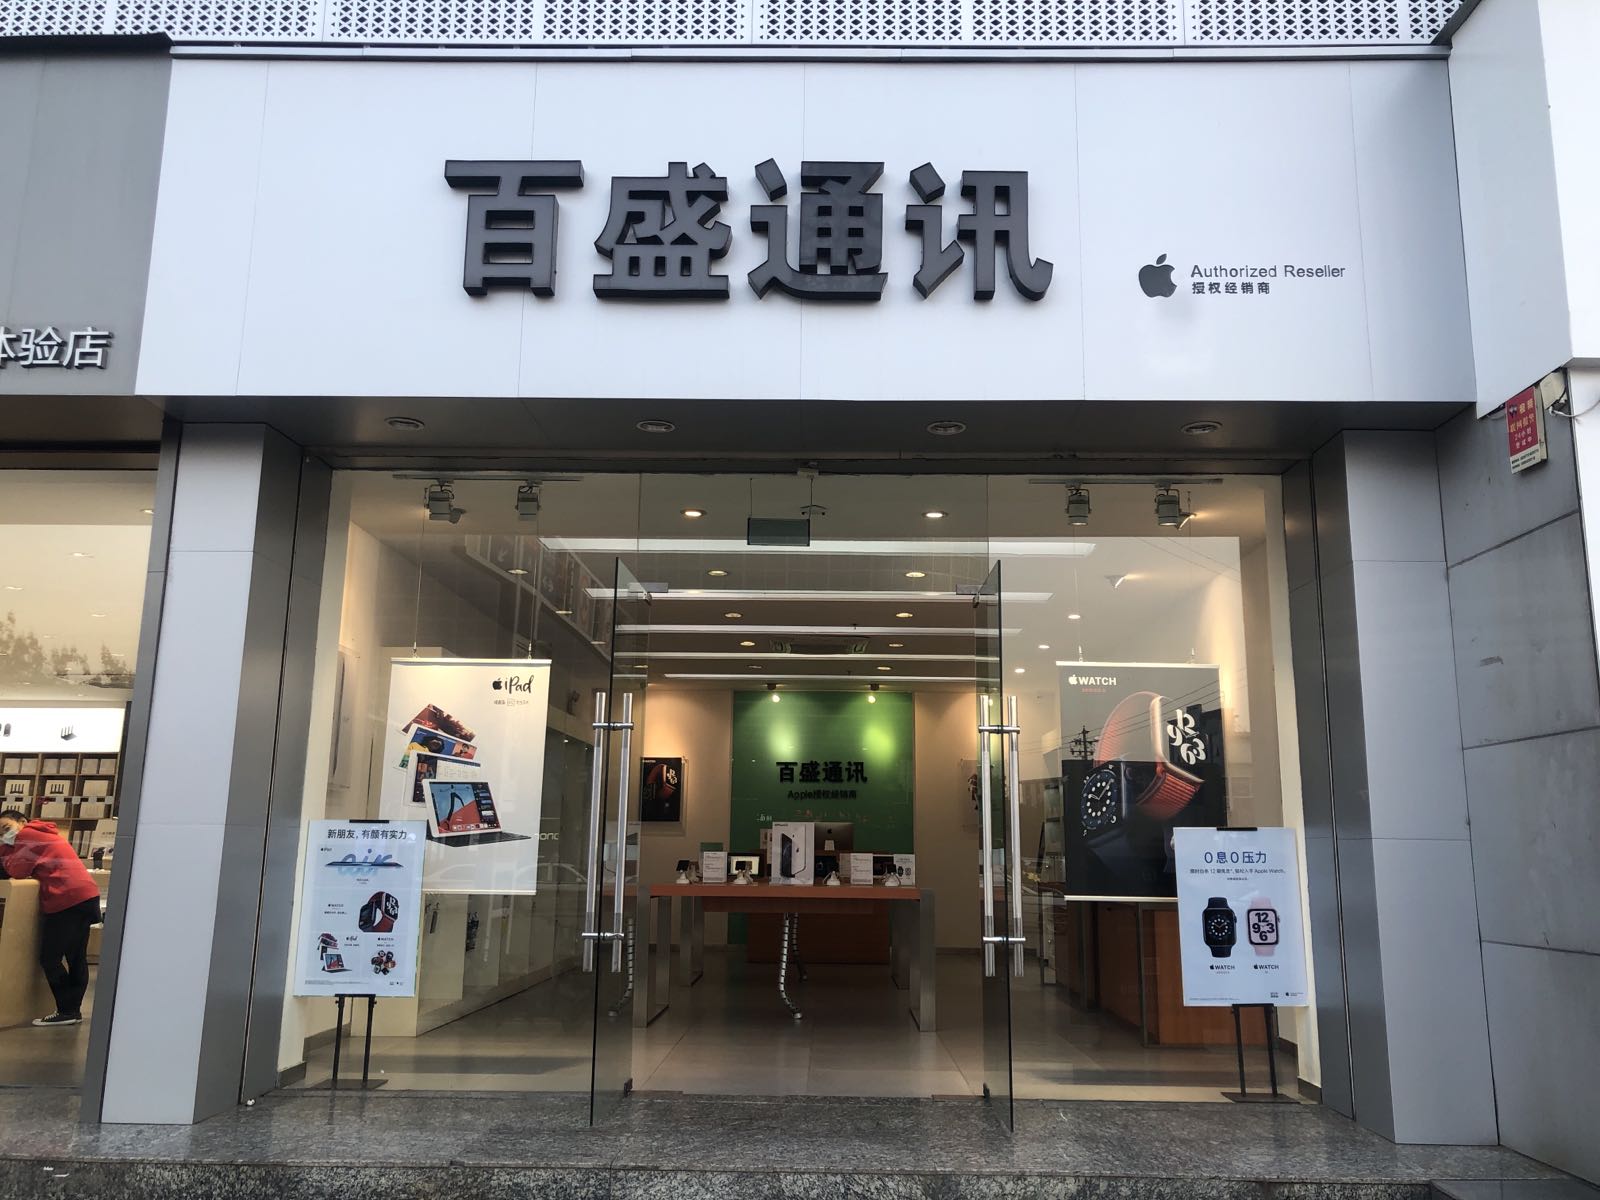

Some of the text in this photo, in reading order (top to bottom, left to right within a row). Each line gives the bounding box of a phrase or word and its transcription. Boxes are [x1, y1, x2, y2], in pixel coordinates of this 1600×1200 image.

[445, 158, 1053, 300] 百盛通讯
[1191, 264, 1346, 278] Authorized Reseller
[1192, 281, 1270, 294] 授权经销商
[504, 675, 535, 694] iPad
[1078, 676, 1117, 686] WATCH
[776, 760, 868, 783] 百盛通讯
[1255, 912, 1269, 923] 12
[1252, 923, 1261, 933] 9
[1266, 922, 1275, 933] 3
[1259, 931, 1268, 941] 6
